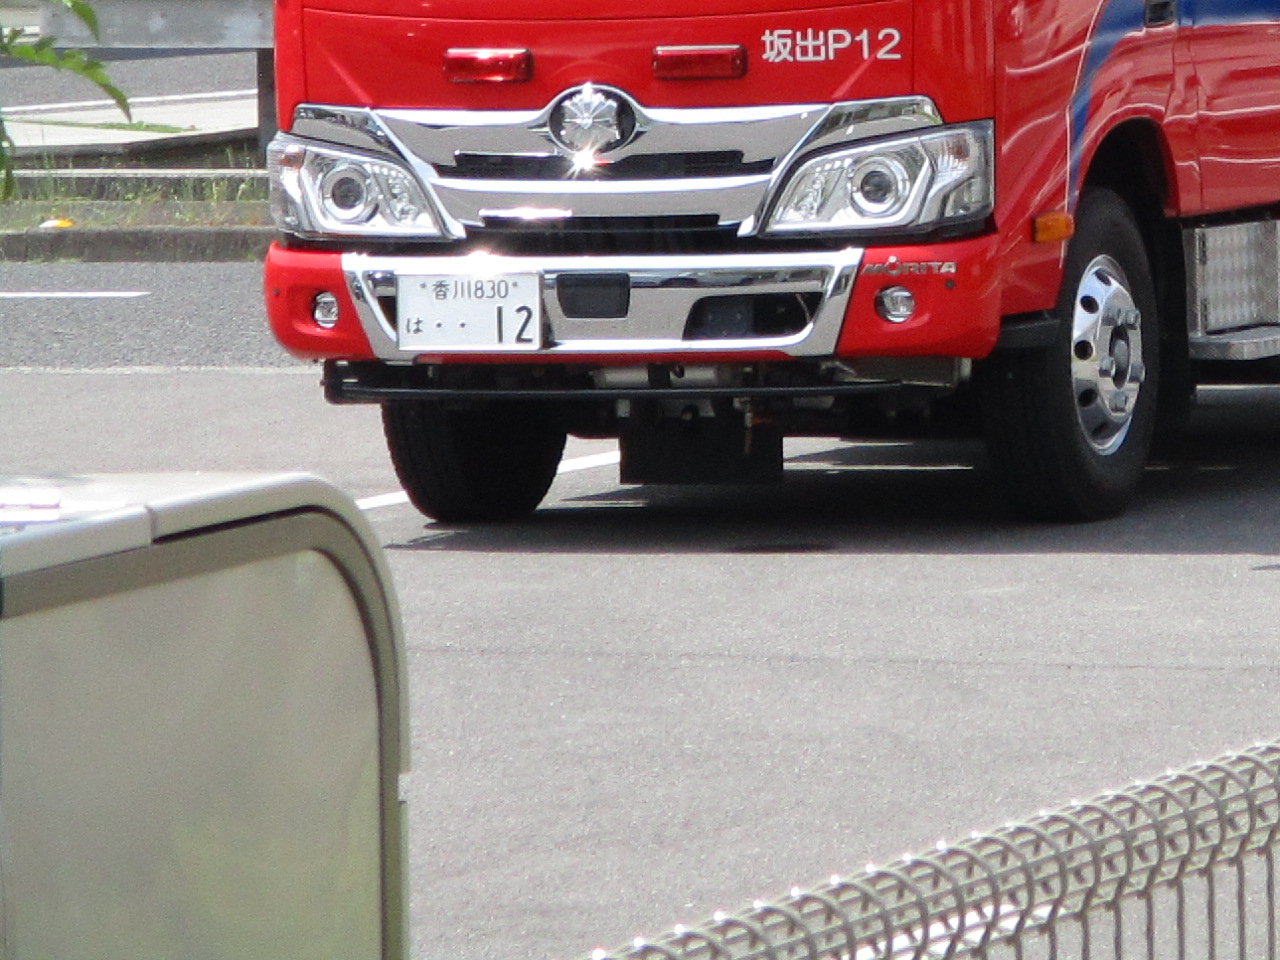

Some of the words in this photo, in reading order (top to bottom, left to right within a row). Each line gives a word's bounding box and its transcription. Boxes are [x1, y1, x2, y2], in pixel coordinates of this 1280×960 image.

[761, 28, 902, 62] 坂出P12
[861, 256, 957, 276] MORITA
[497, 305, 533, 343] 12
